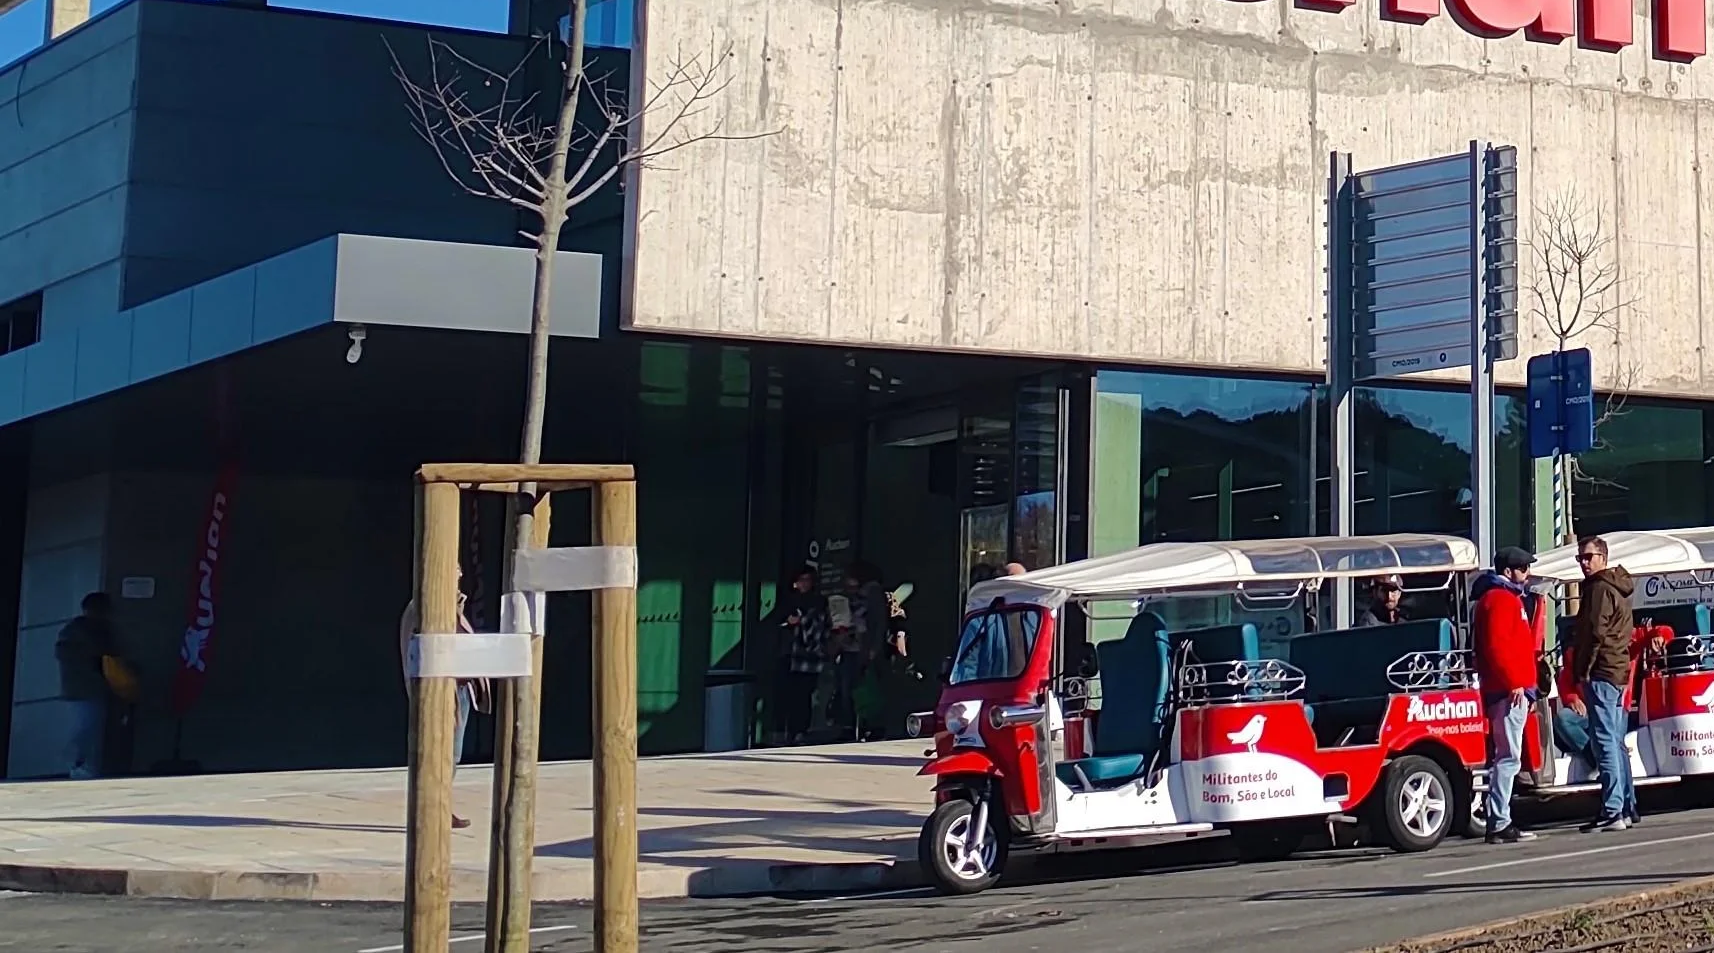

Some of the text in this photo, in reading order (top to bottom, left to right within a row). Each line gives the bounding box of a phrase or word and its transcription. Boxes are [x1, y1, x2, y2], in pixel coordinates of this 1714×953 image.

[1407, 694, 1478, 722] Auchan
[1671, 746, 1699, 758] Bom,
[1202, 770, 1277, 785] Militantes do
[1203, 785, 1295, 804] Bom, São e Local
